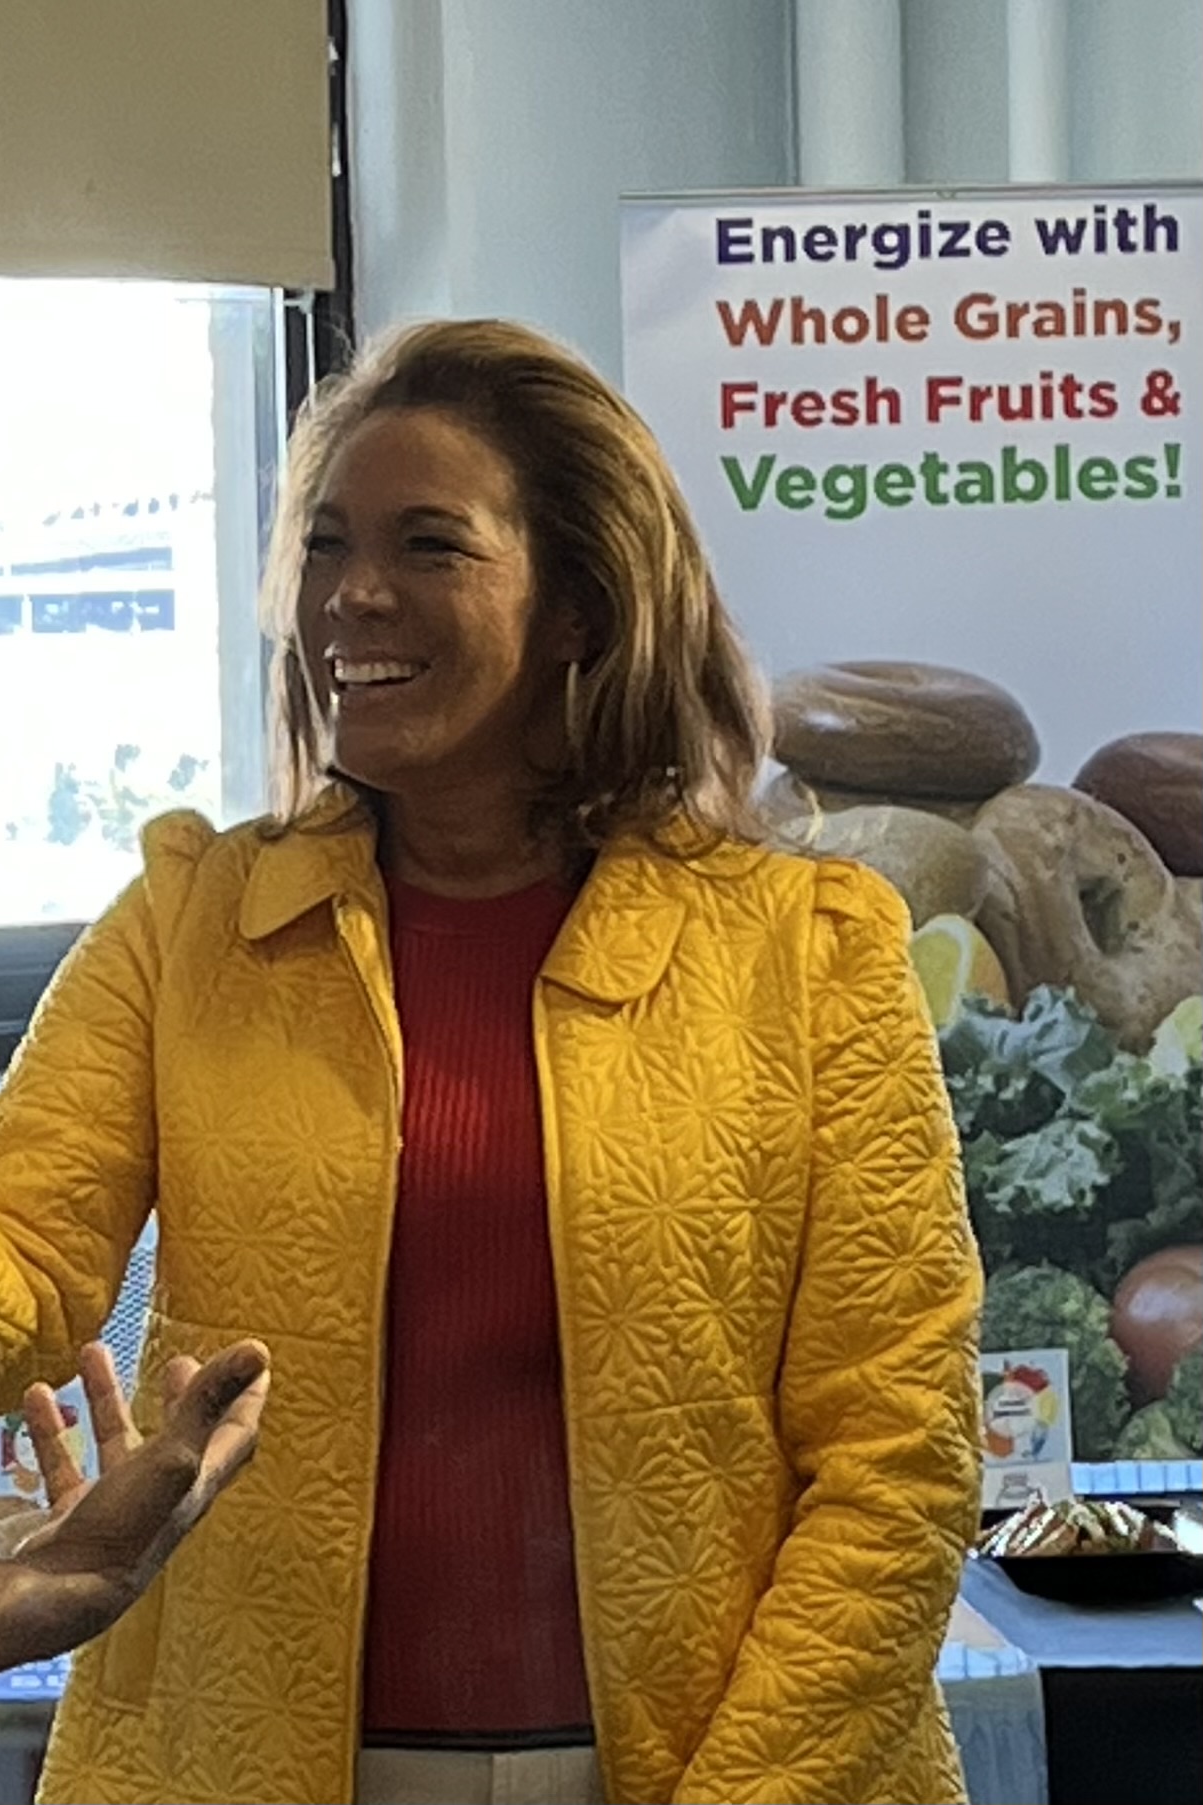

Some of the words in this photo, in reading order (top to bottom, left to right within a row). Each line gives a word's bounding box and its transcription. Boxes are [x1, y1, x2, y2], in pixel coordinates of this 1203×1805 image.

[715, 209, 1012, 271] Energize
[1033, 202, 1179, 256] with
[715, 293, 931, 348] Whole
[953, 287, 1181, 345] Grains,
[720, 375, 902, 430] Fresh
[925, 370, 1119, 424] Fruits
[1139, 368, 1181, 418] &
[720, 442, 1181, 521] Vegetables!
